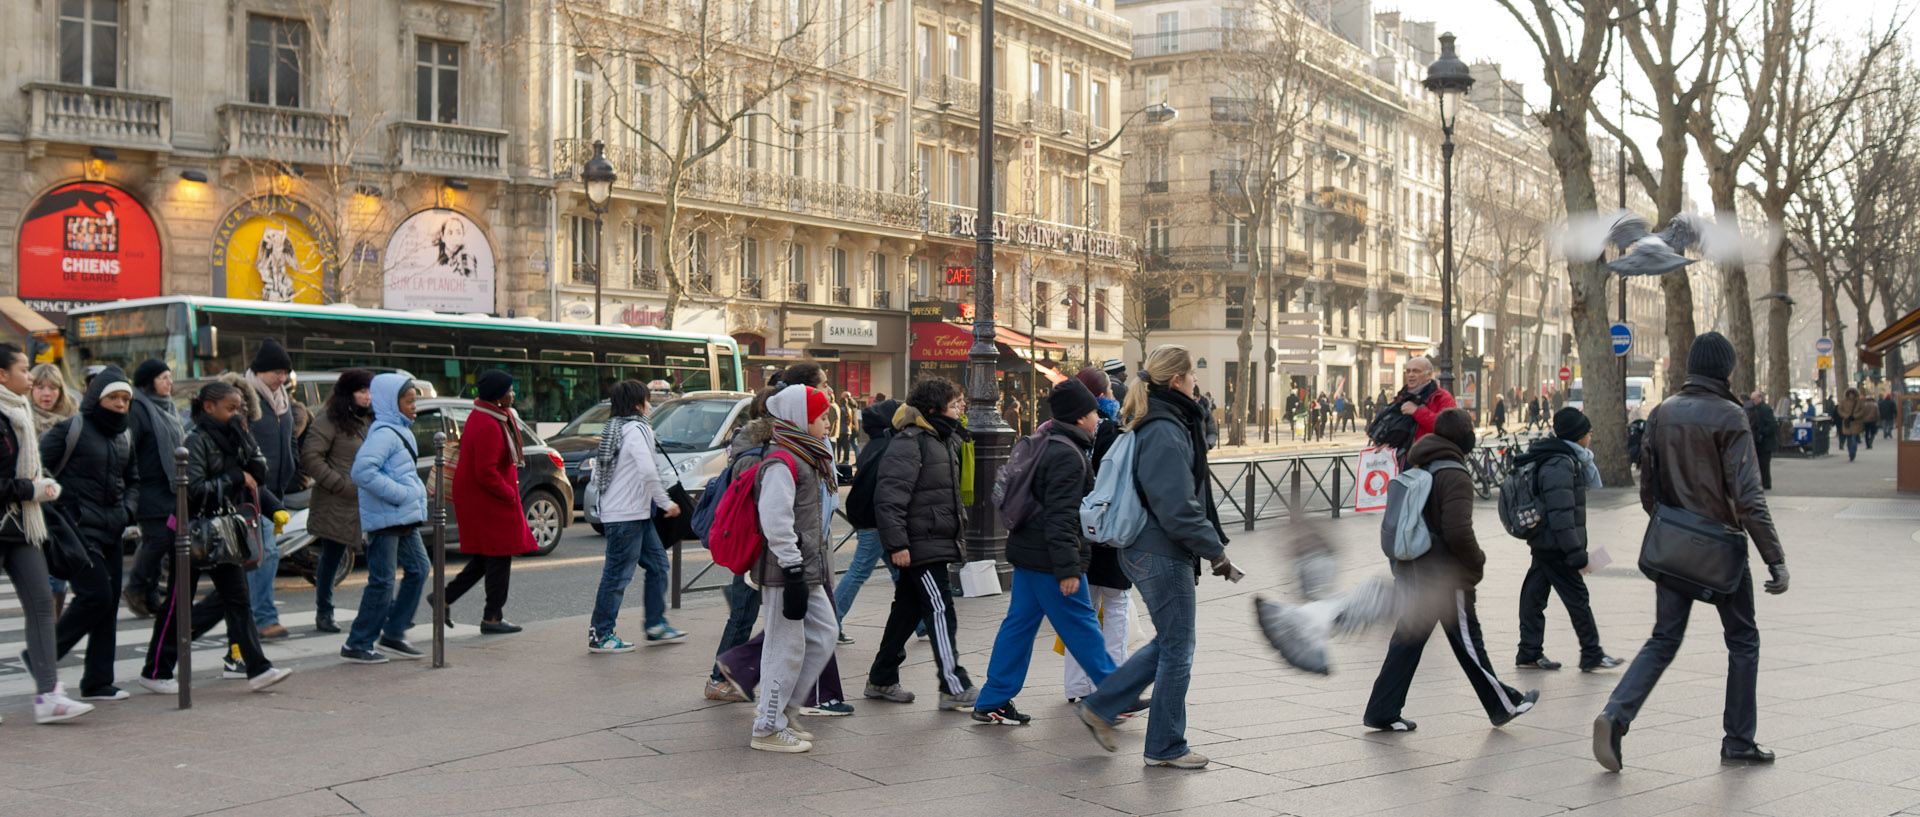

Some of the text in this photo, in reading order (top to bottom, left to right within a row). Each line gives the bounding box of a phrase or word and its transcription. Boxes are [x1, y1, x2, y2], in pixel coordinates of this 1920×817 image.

[213, 209, 244, 267] ESPACE
[250, 197, 297, 213] SAINT
[959, 212, 1011, 241] ROAL
[1017, 222, 1061, 249] SAINT
[62, 256, 121, 275] CHIENS
[63, 271, 119, 284] DE GARDE
[945, 268, 972, 284] CAFE
[390, 276, 411, 290] SUR
[413, 277, 425, 290] LA
[427, 278, 468, 293] PLANCHE
[25, 300, 70, 312] ESPACE
[622, 303, 665, 327] claire
[829, 326, 845, 336] SAN
[922, 348, 969, 356] DE LA FONTA
[1798, 429, 1808, 440] P
